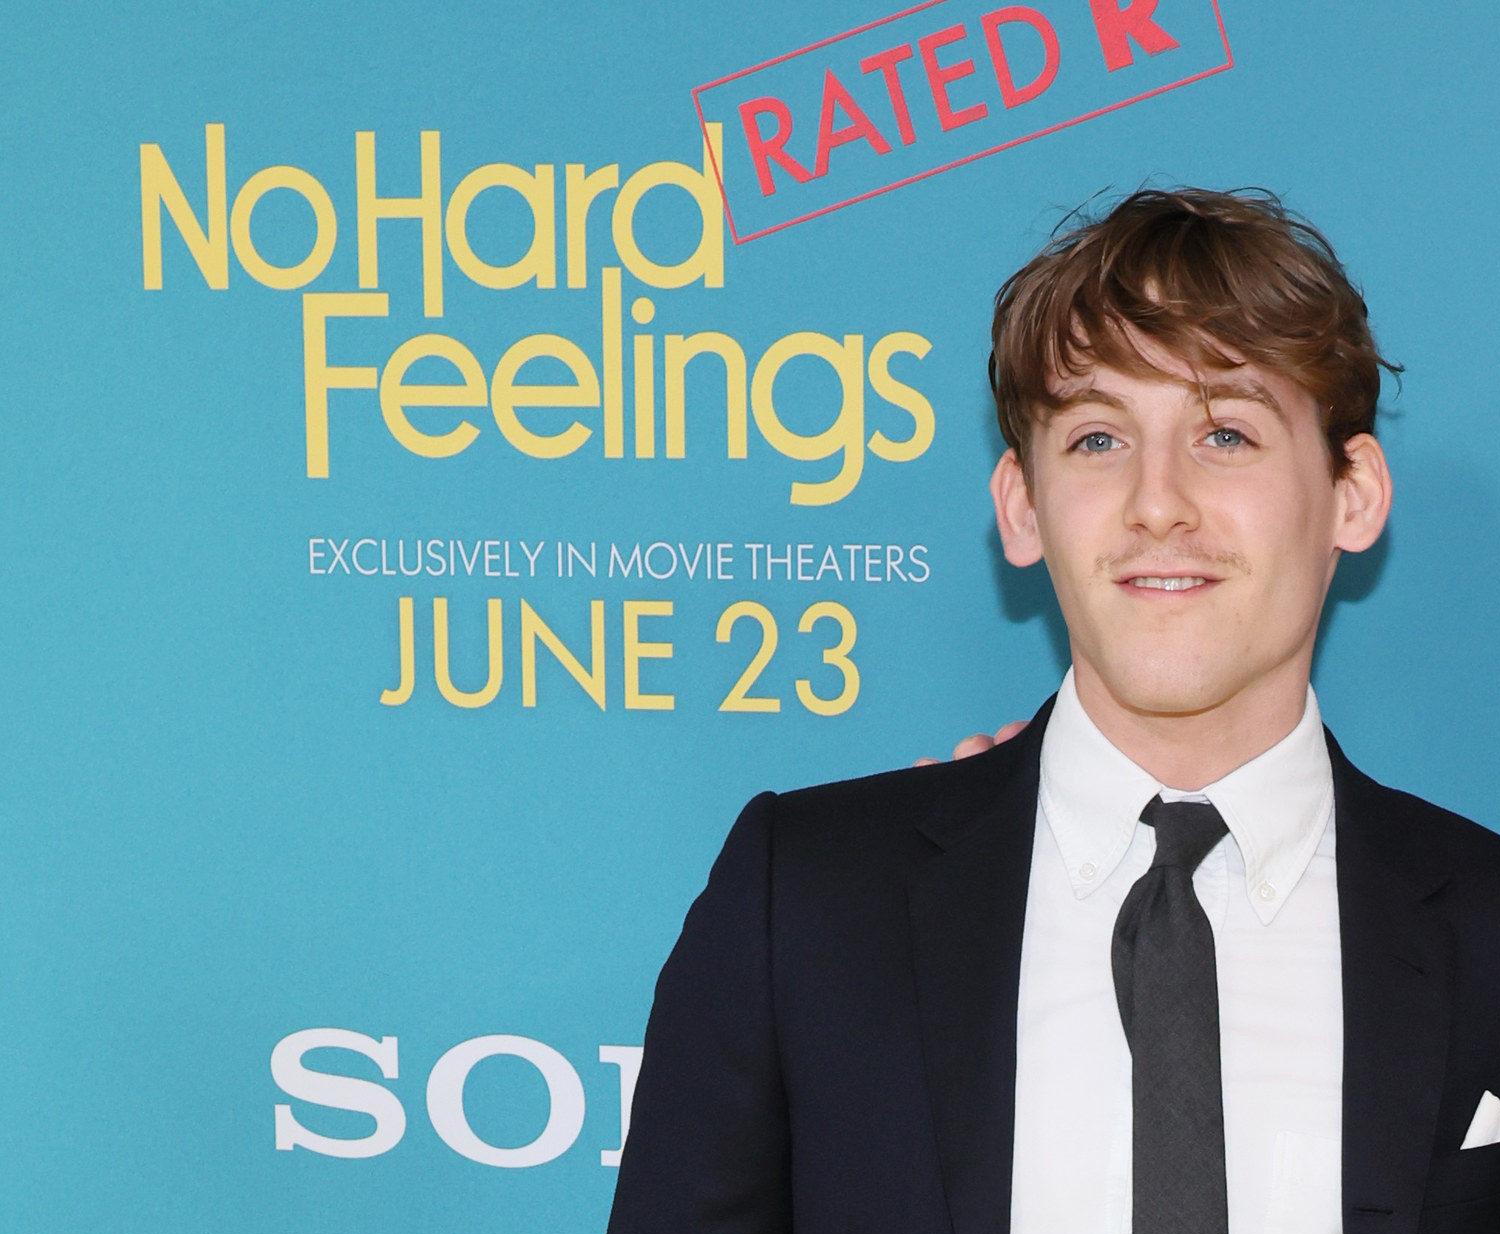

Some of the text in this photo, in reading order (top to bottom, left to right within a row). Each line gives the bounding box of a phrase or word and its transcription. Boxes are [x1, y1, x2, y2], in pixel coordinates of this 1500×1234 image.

[738, 0, 1180, 197] RATED R
[140, 122, 725, 318] No Hard
[302, 267, 936, 506] Feelings
[309, 538, 931, 583] EXCLUSIVELY IN MOVIE THEATERS
[380, 596, 860, 716] JUNE 23
